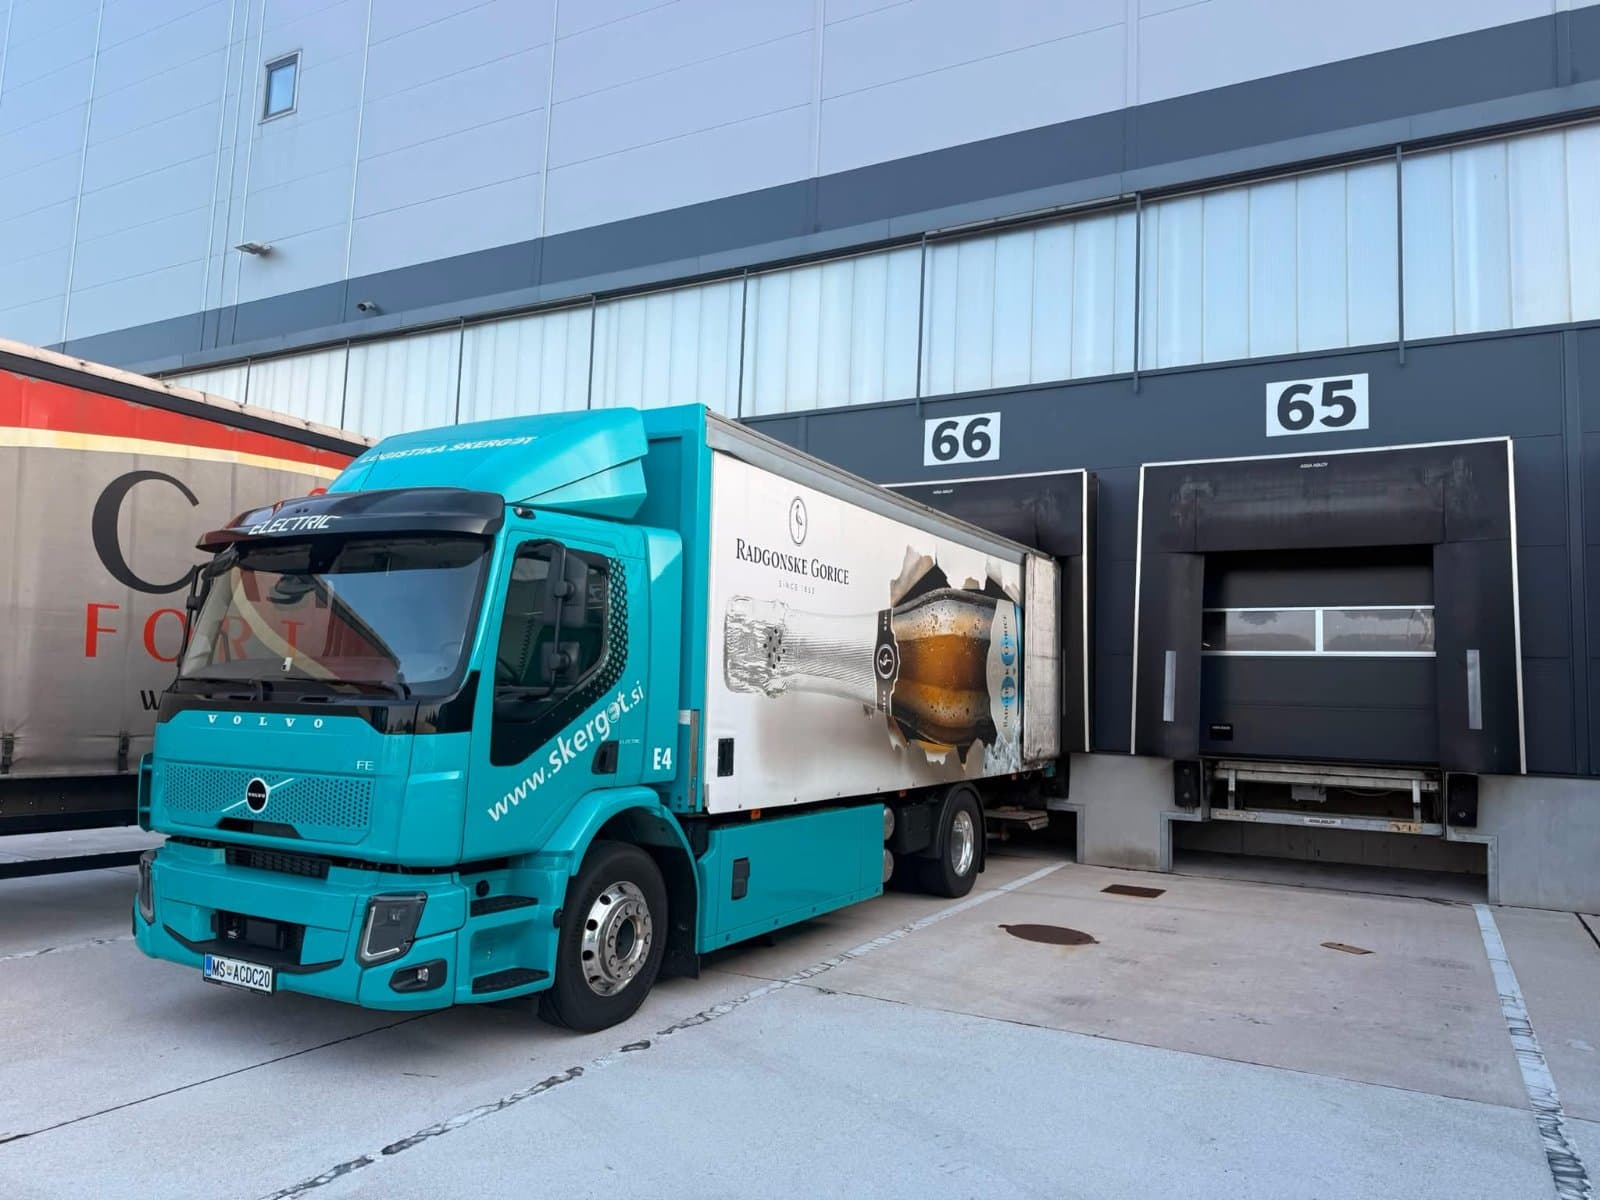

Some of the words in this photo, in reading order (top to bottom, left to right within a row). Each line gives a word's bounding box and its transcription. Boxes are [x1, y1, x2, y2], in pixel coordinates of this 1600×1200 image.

[1277, 379, 1357, 431] 65
[931, 417, 991, 461] 66
[248, 515, 342, 535] ELECTRIC
[736, 538, 808, 575] RADGONSKE
[811, 558, 849, 585] GORICE
[208, 714, 324, 729] VOLVO
[356, 760, 375, 771] FE
[653, 747, 672, 770] E4
[212, 959, 226, 978] MS
[233, 964, 270, 988] ACDC20
